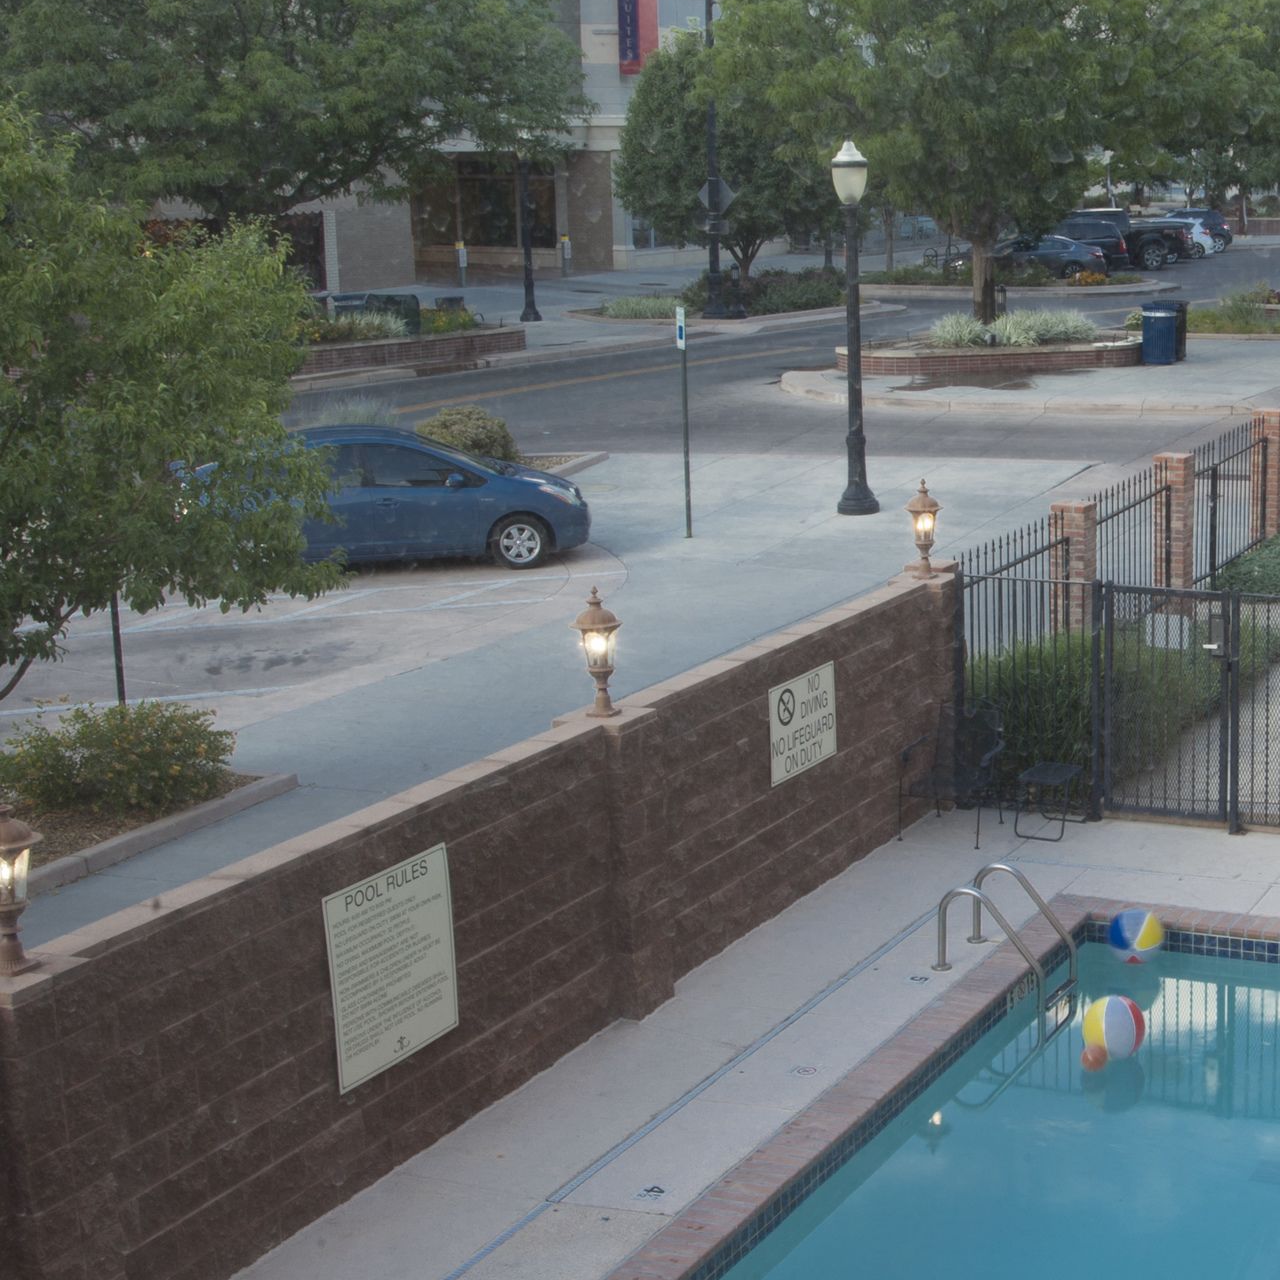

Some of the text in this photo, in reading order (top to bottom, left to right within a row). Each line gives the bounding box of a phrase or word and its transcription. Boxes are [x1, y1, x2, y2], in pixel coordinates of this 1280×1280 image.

[807, 673, 820, 693] NO
[800, 690, 828, 719] DIVING
[772, 713, 834, 759] NO LIFEGUARD
[785, 738, 823, 773] ON DUTY
[344, 859, 428, 912] POOL RULES
